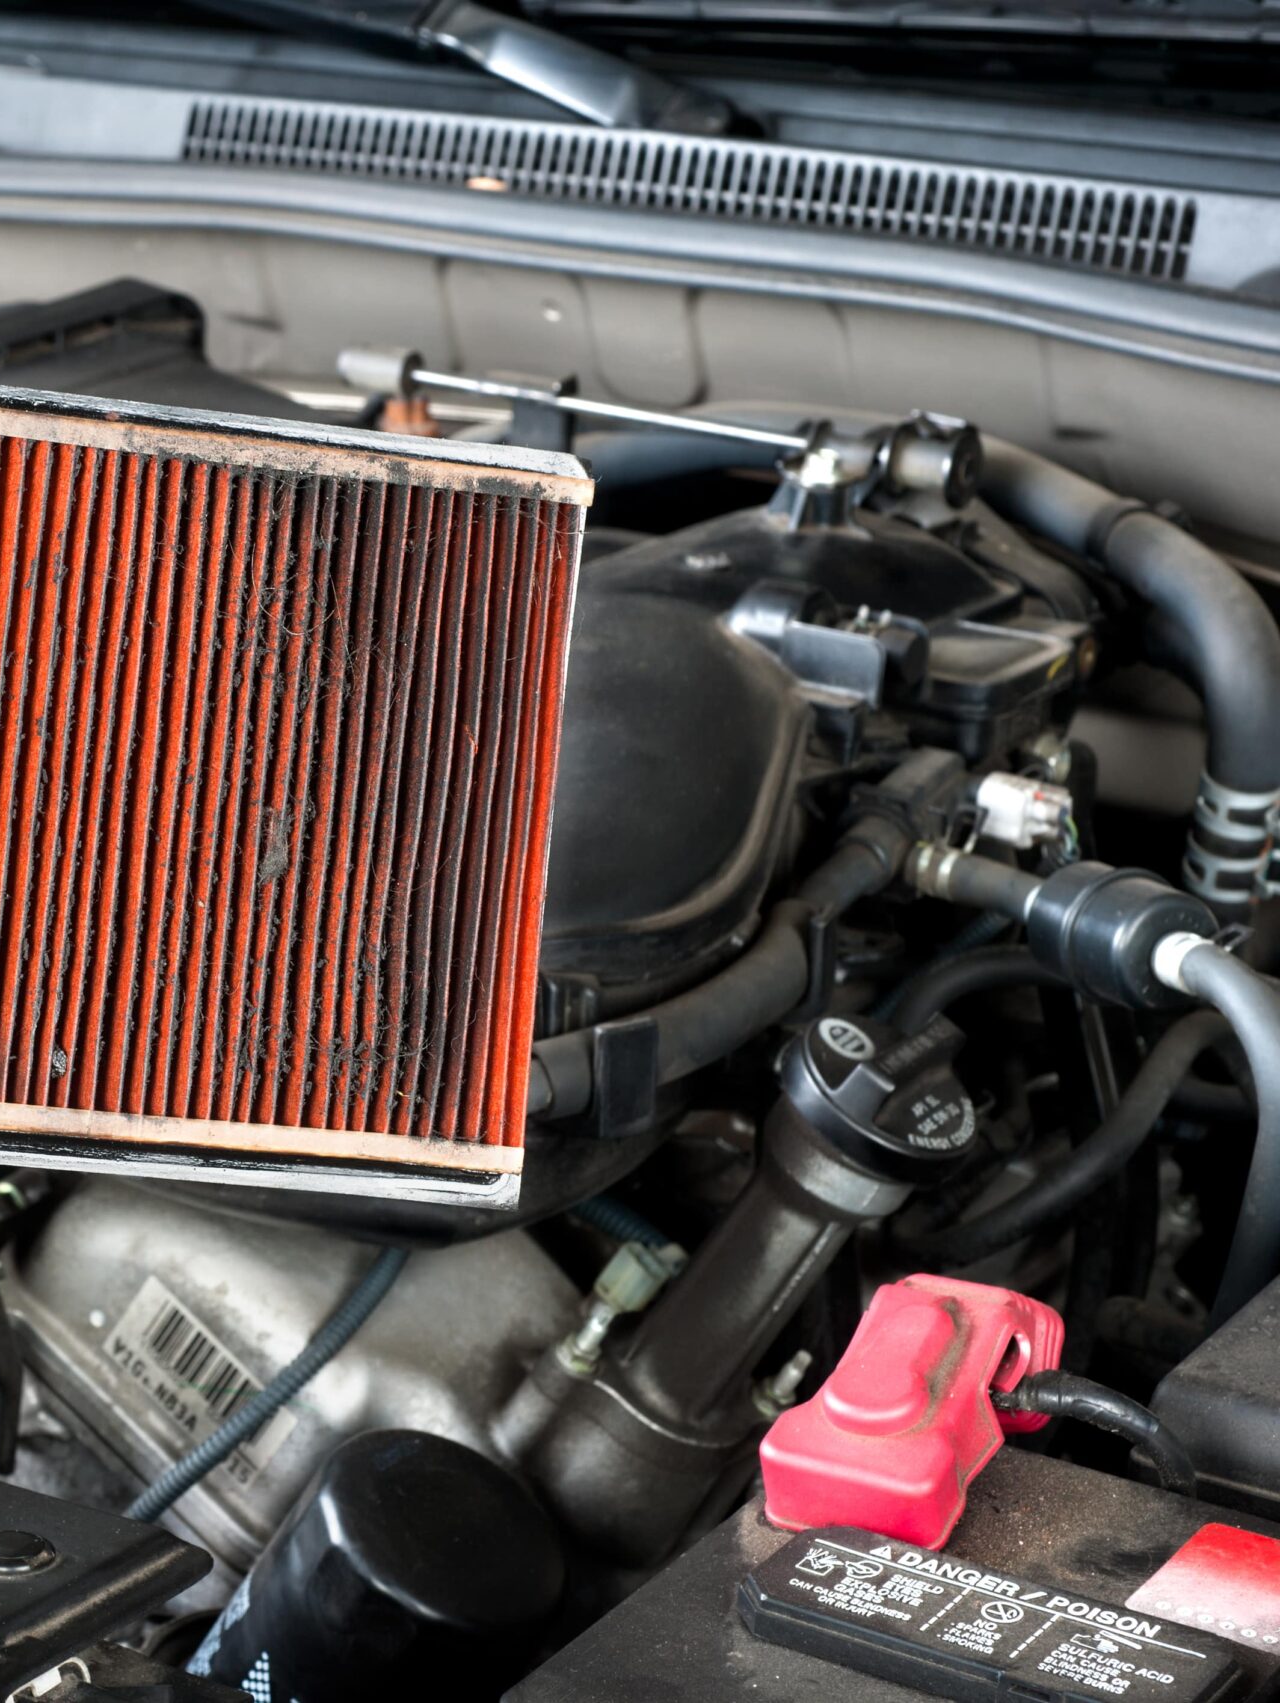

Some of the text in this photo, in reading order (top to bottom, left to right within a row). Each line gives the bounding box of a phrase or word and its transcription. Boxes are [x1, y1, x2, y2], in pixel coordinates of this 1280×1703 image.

[907, 1133, 952, 1150] ENERGY
[833, 1584, 885, 1604] GASES
[840, 1577, 924, 1607] EXPLOSIVE
[882, 1581, 924, 1598] EYES
[890, 1573, 945, 1595] SHIELD
[897, 1551, 1021, 1597] DANGER
[1045, 1595, 1162, 1639] POISON
[788, 1578, 912, 1621] CAN CAUSE BLINDNESS
[834, 1600, 877, 1618] INJURY
[973, 1619, 998, 1632] NO
[1043, 1655, 1131, 1688] BLINDNESS OR
[1050, 1650, 1122, 1678] CAN CAUSE
[1058, 1643, 1175, 1685] SULFURIC ACID
[1037, 1662, 1126, 1695] SEVERE BURNS
